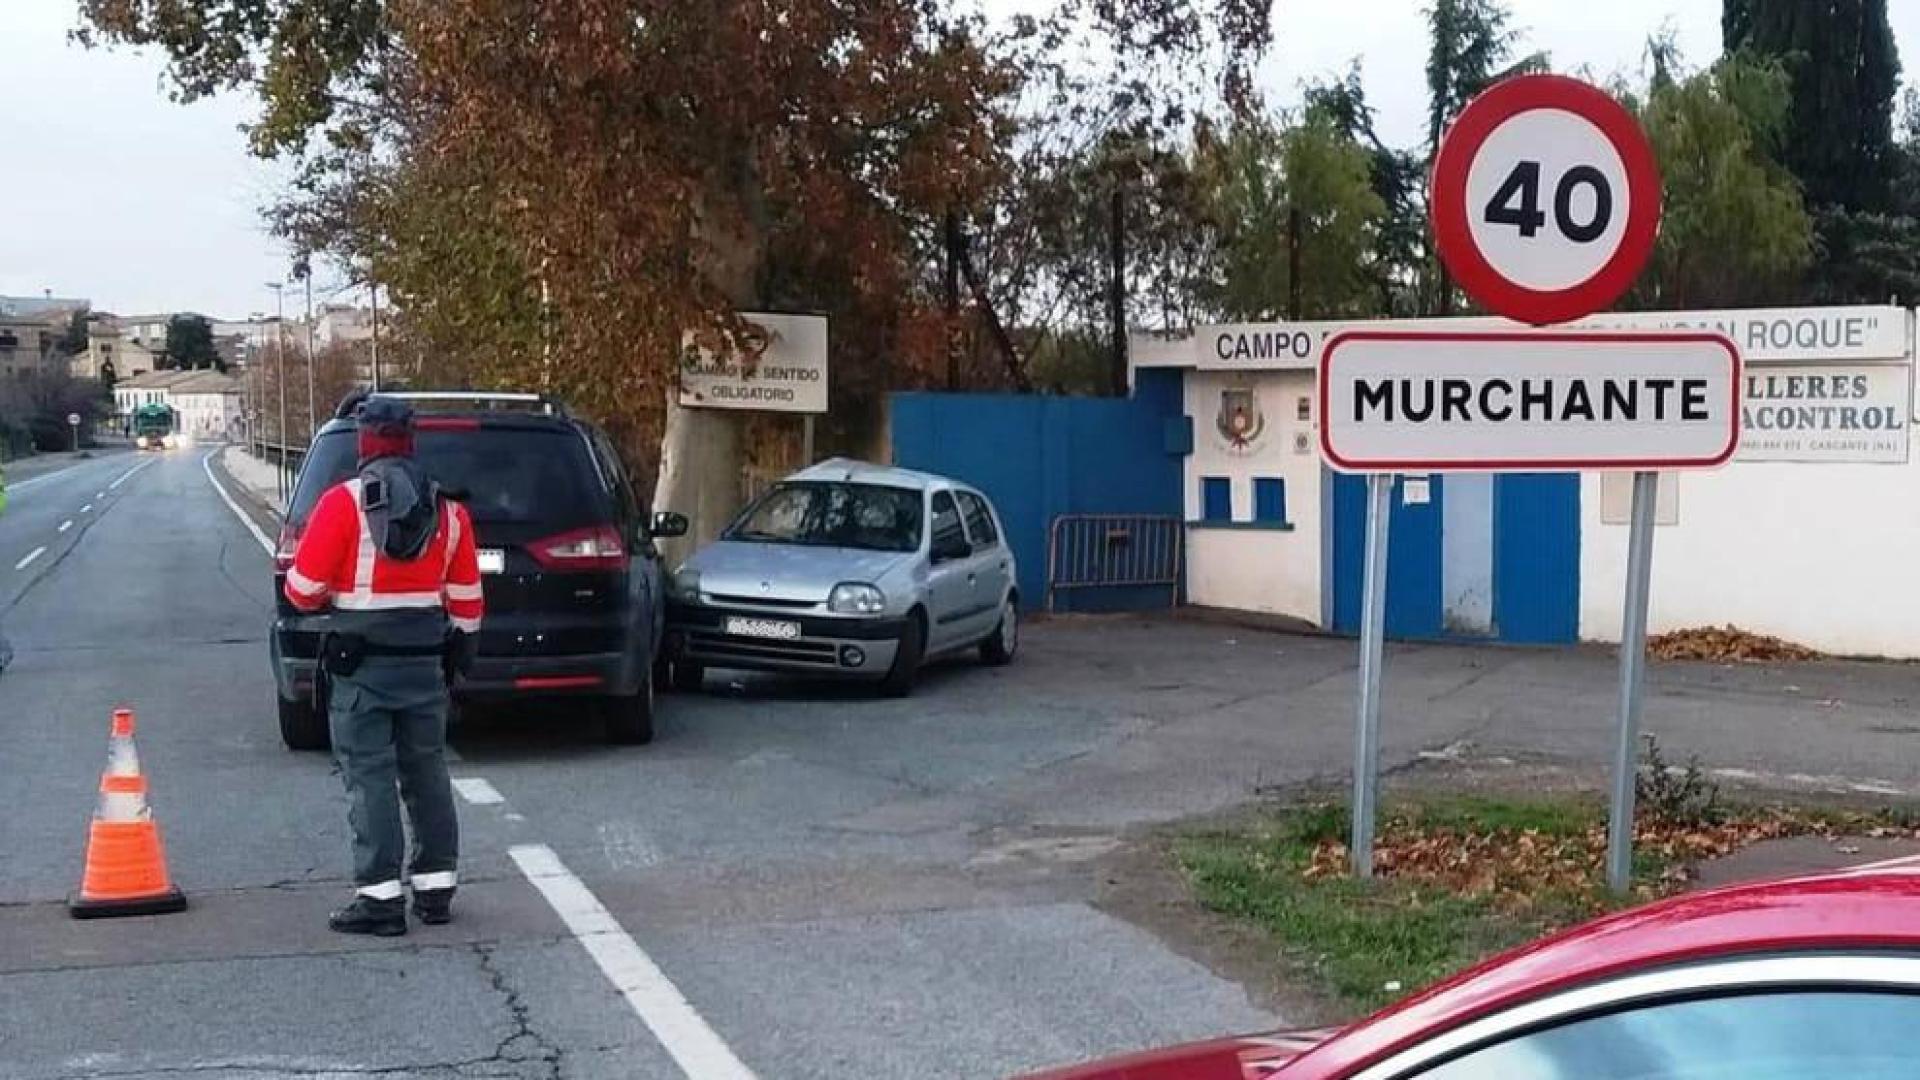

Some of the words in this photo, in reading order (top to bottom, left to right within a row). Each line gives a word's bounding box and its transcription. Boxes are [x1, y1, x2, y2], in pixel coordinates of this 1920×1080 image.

[1484, 161, 1612, 243] 40
[1216, 332, 1311, 360] CAMPO
[1747, 317, 1878, 349] ROQUE"
[711, 385, 794, 402] OBLIGATORIO
[763, 367, 820, 381] SENTIDO
[1353, 379, 1709, 422] MURCHANTE
